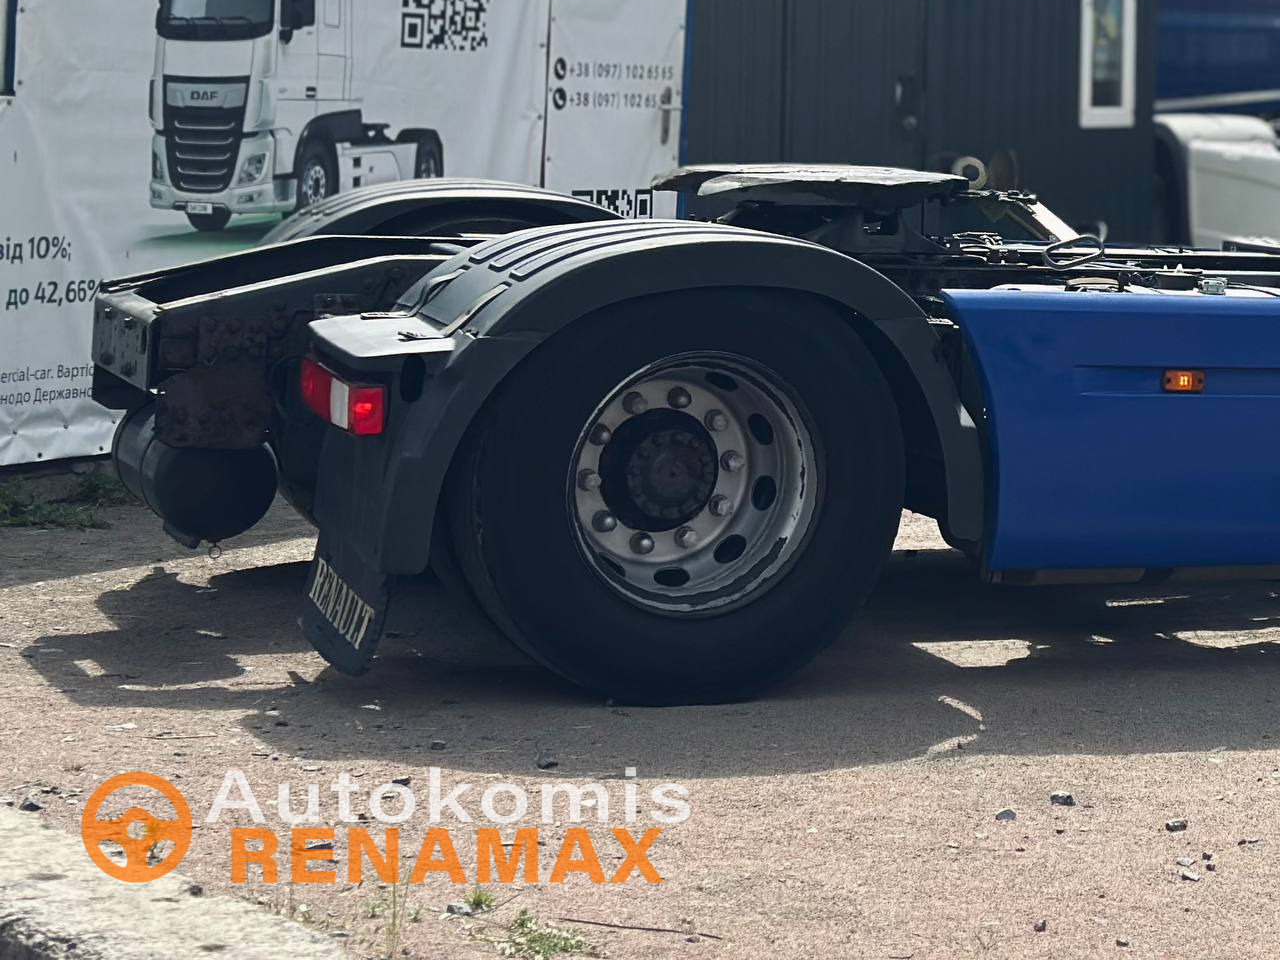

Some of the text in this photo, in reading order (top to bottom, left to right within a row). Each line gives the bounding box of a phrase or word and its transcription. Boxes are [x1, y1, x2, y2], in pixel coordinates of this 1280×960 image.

[567, 62, 590, 78] +38
[593, 60, 622, 79] (097)
[625, 64, 645, 80] 102
[190, 91, 219, 101] DAF
[567, 91, 590, 107] +38
[623, 93, 643, 108] 102
[28, 236, 71, 262] 10%;
[5, 288, 29, 311] до
[308, 557, 375, 650] RENAULT
